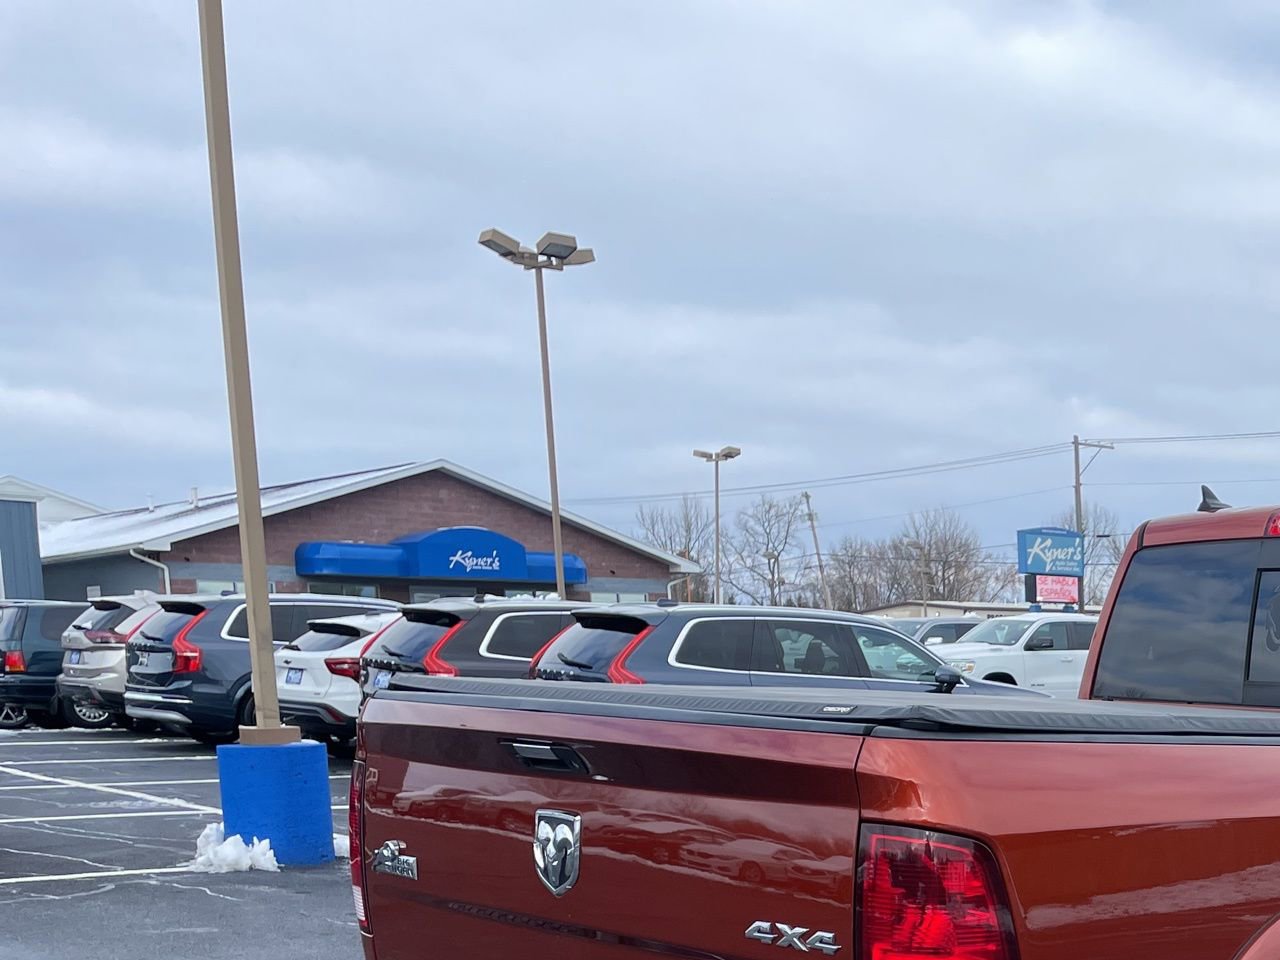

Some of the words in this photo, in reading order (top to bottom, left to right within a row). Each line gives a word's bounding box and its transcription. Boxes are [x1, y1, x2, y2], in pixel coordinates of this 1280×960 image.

[449, 550, 500, 572] Kyner's
[1027, 537, 1081, 572] Kyner's
[1038, 576, 1048, 585] SE
[1051, 577, 1076, 586] HABLA
[398, 857, 412, 868] BIG
[391, 864, 414, 878] HORN
